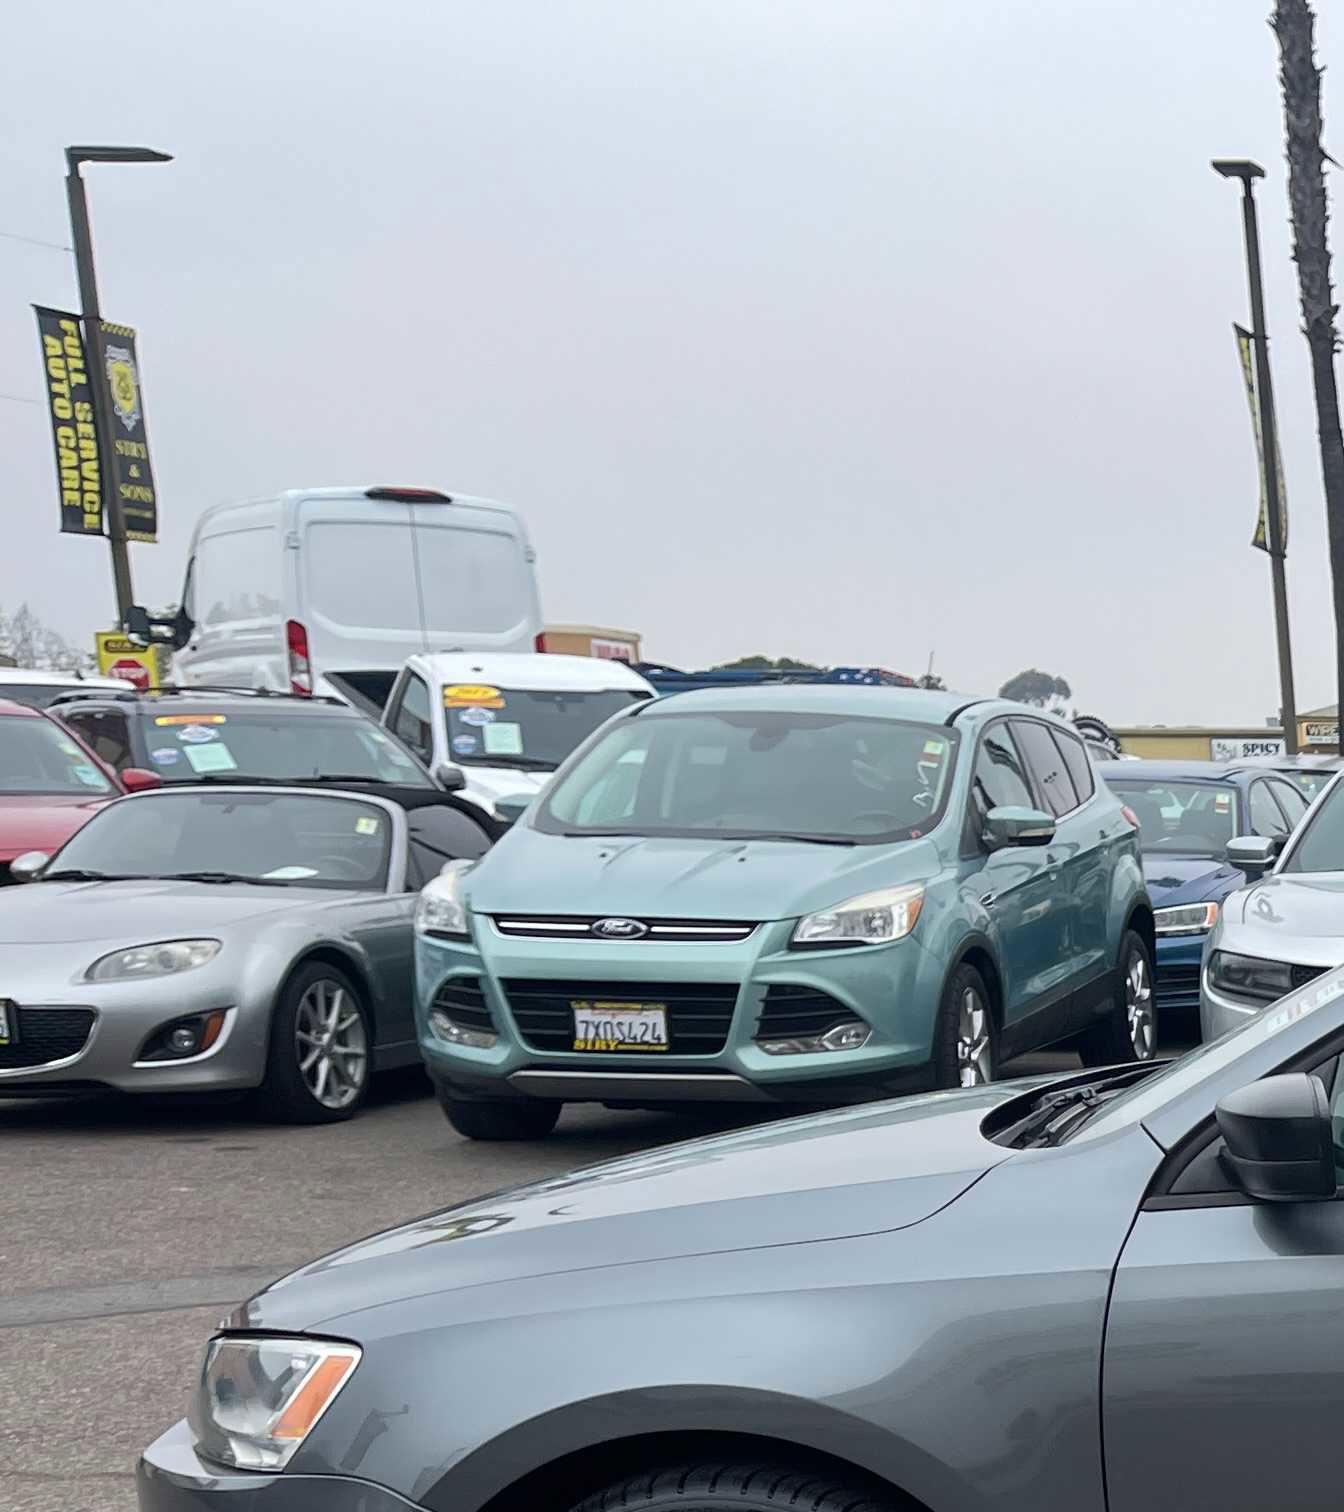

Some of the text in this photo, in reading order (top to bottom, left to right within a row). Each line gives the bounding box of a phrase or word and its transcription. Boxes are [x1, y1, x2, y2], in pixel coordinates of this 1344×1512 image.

[43, 335, 81, 507] AUTO CARE
[59, 319, 100, 528] FULL SERVICE
[129, 464, 140, 478] &
[119, 484, 154, 503] SONS
[1242, 743, 1281, 754] SPICY
